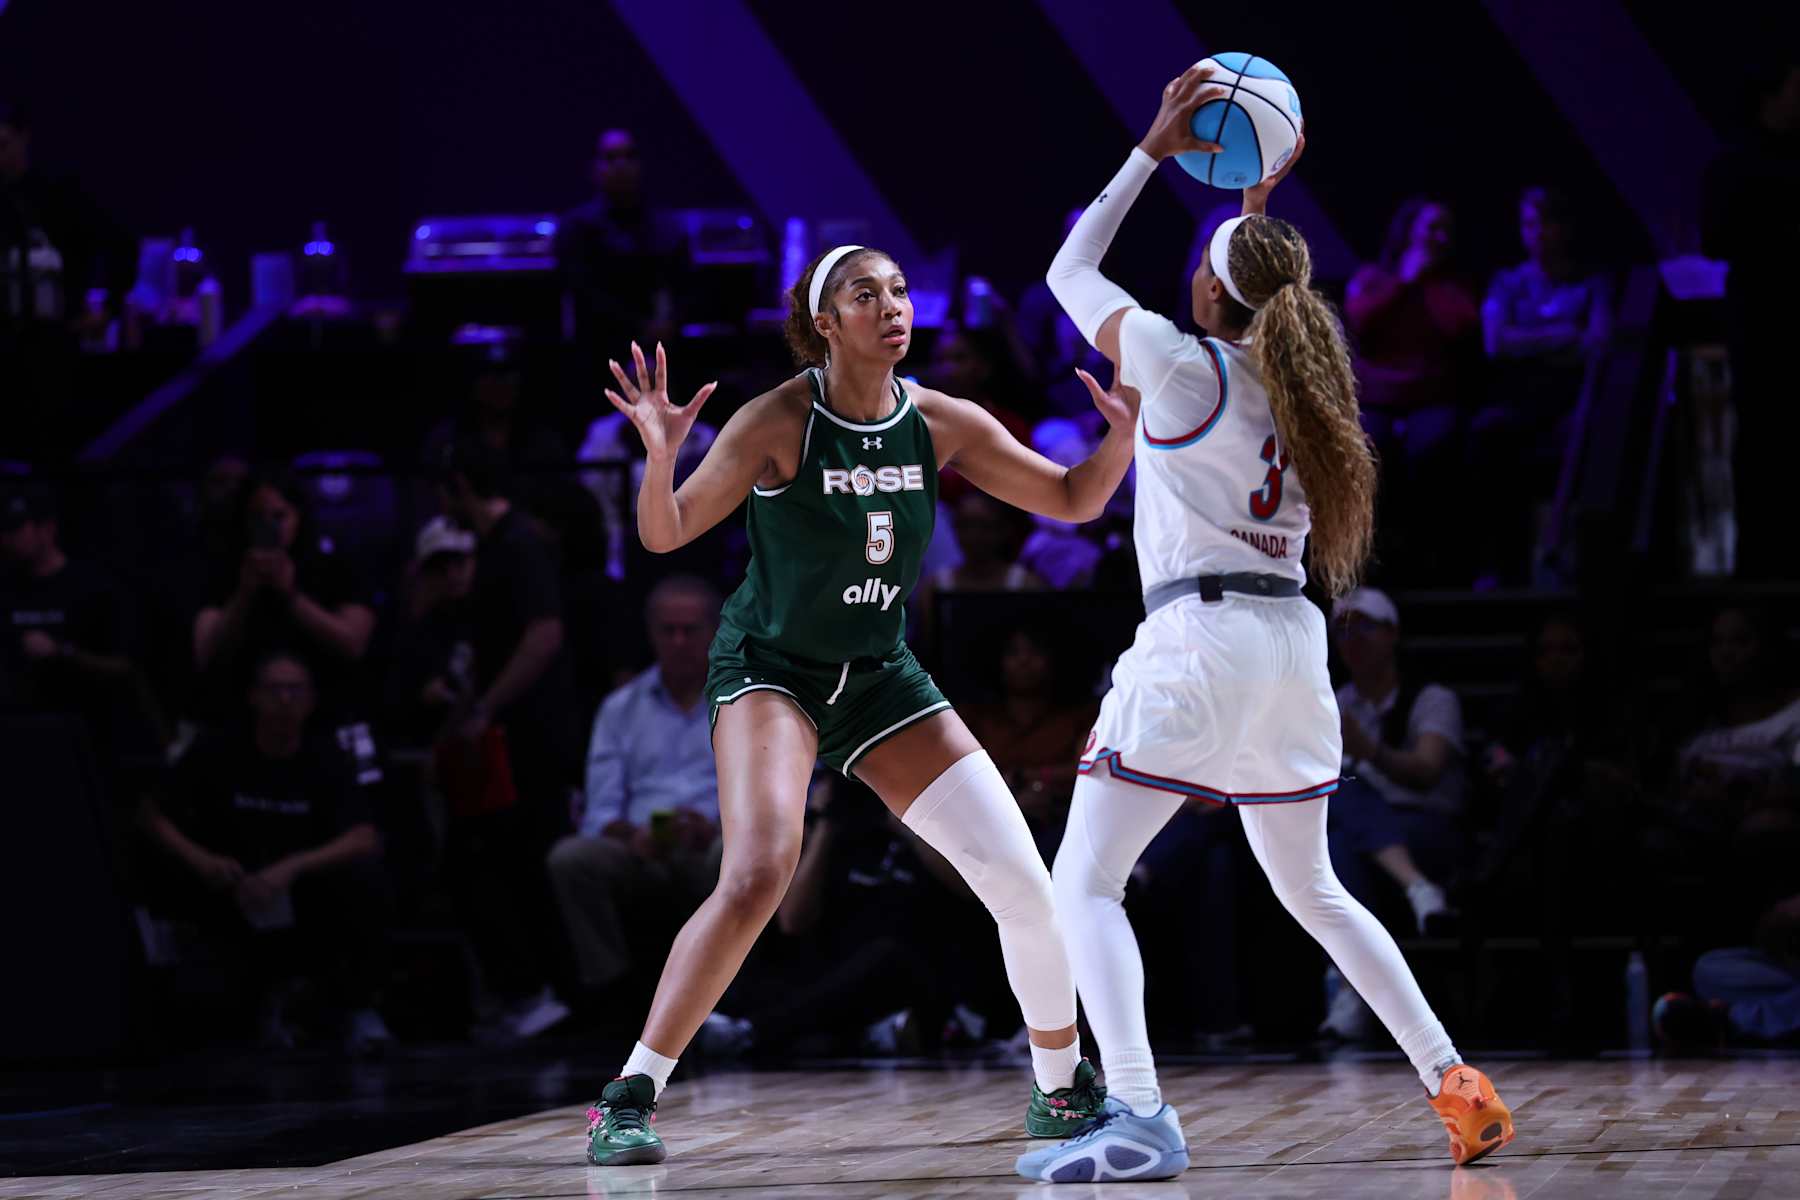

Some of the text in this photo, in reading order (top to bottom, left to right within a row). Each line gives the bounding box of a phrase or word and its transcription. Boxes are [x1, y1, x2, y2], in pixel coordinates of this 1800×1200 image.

[823, 464, 924, 496] ROSE
[1249, 434, 1290, 521] 3
[865, 511, 894, 565] 5
[842, 578, 900, 611] ally
